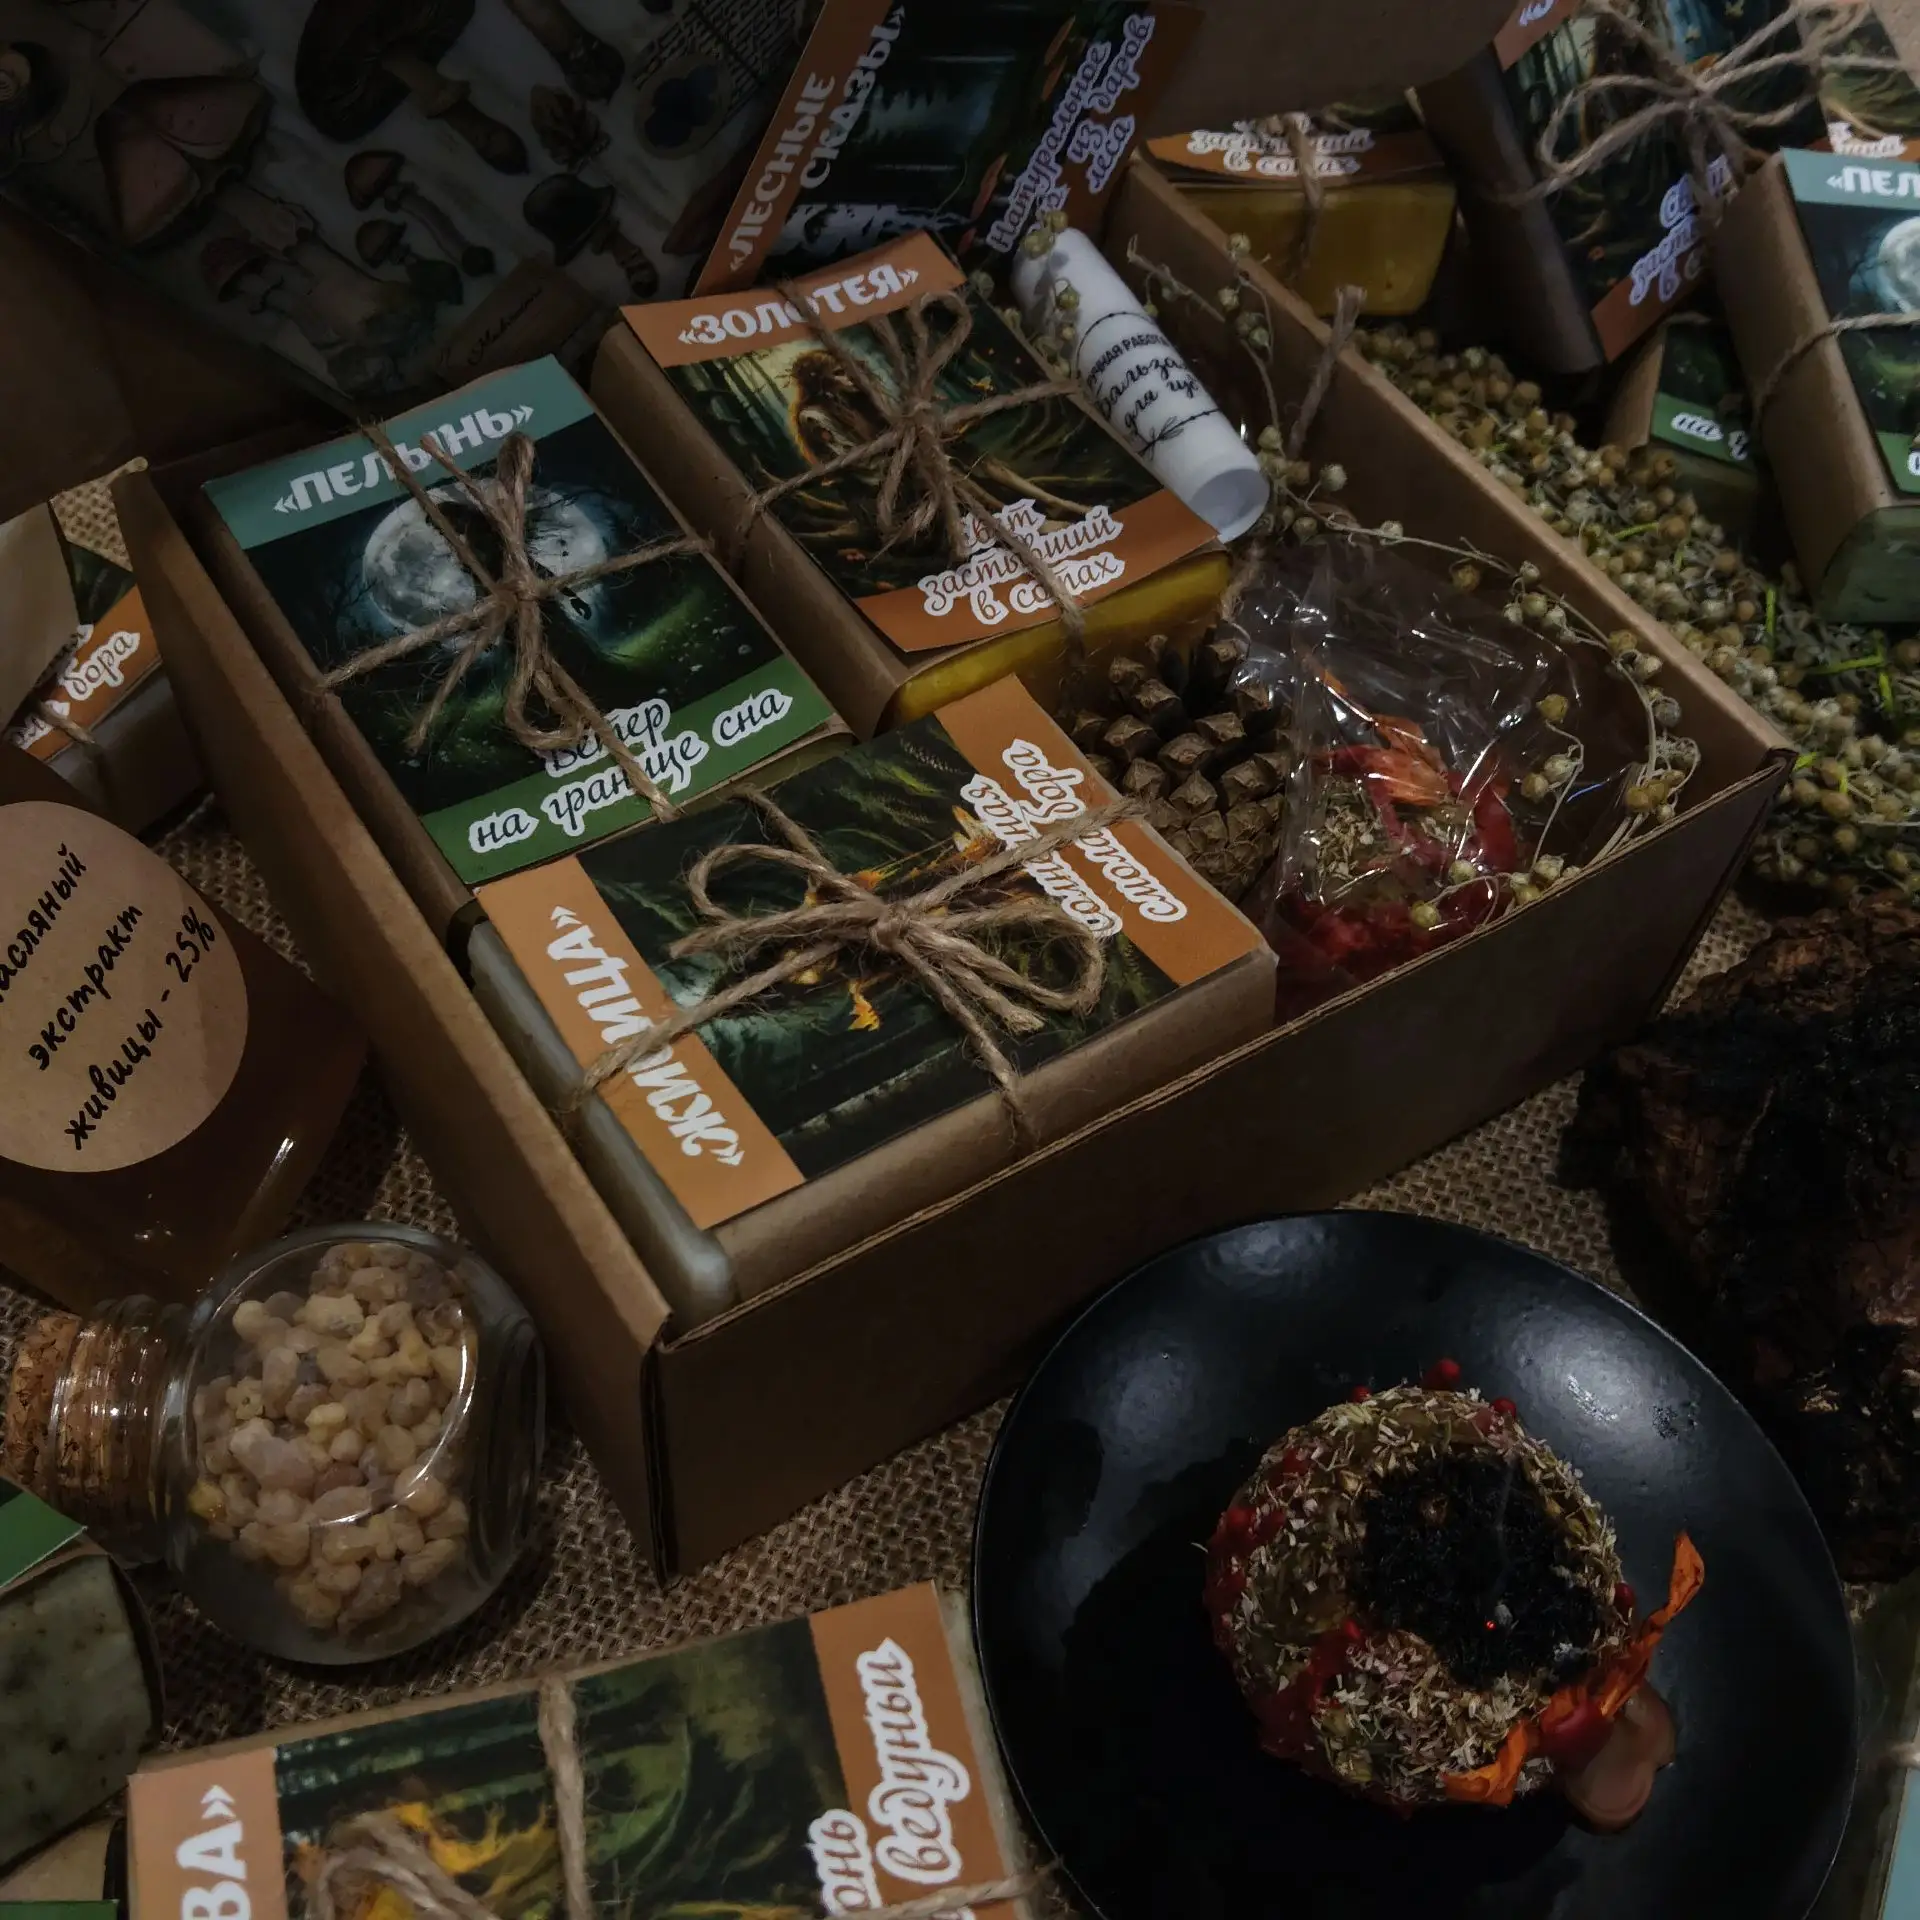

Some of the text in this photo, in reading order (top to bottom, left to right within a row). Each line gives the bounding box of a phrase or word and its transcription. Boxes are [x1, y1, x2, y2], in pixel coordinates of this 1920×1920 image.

[800, 4, 906, 189] СКАЗЫ»
[1085, 15, 1155, 113] даров
[729, 71, 836, 272] «ЛЕСНЫЕ
[987, 43, 1111, 250] Натуральное
[1088, 117, 1134, 192] леса
[273, 404, 535, 514] «ПЕЛЫНЬ»
[62, 635, 136, 695] бора
[974, 588, 1003, 622] в
[475, 812, 535, 848] на
[718, 693, 788, 742] сна
[1007, 743, 1084, 822] бора
[0, 843, 87, 1003] асляный
[29, 906, 143, 1070] экстракт
[65, 1008, 163, 1150] живицы
[166, 906, 216, 983] 25%
[864, 1648, 964, 1876] ведуньи
